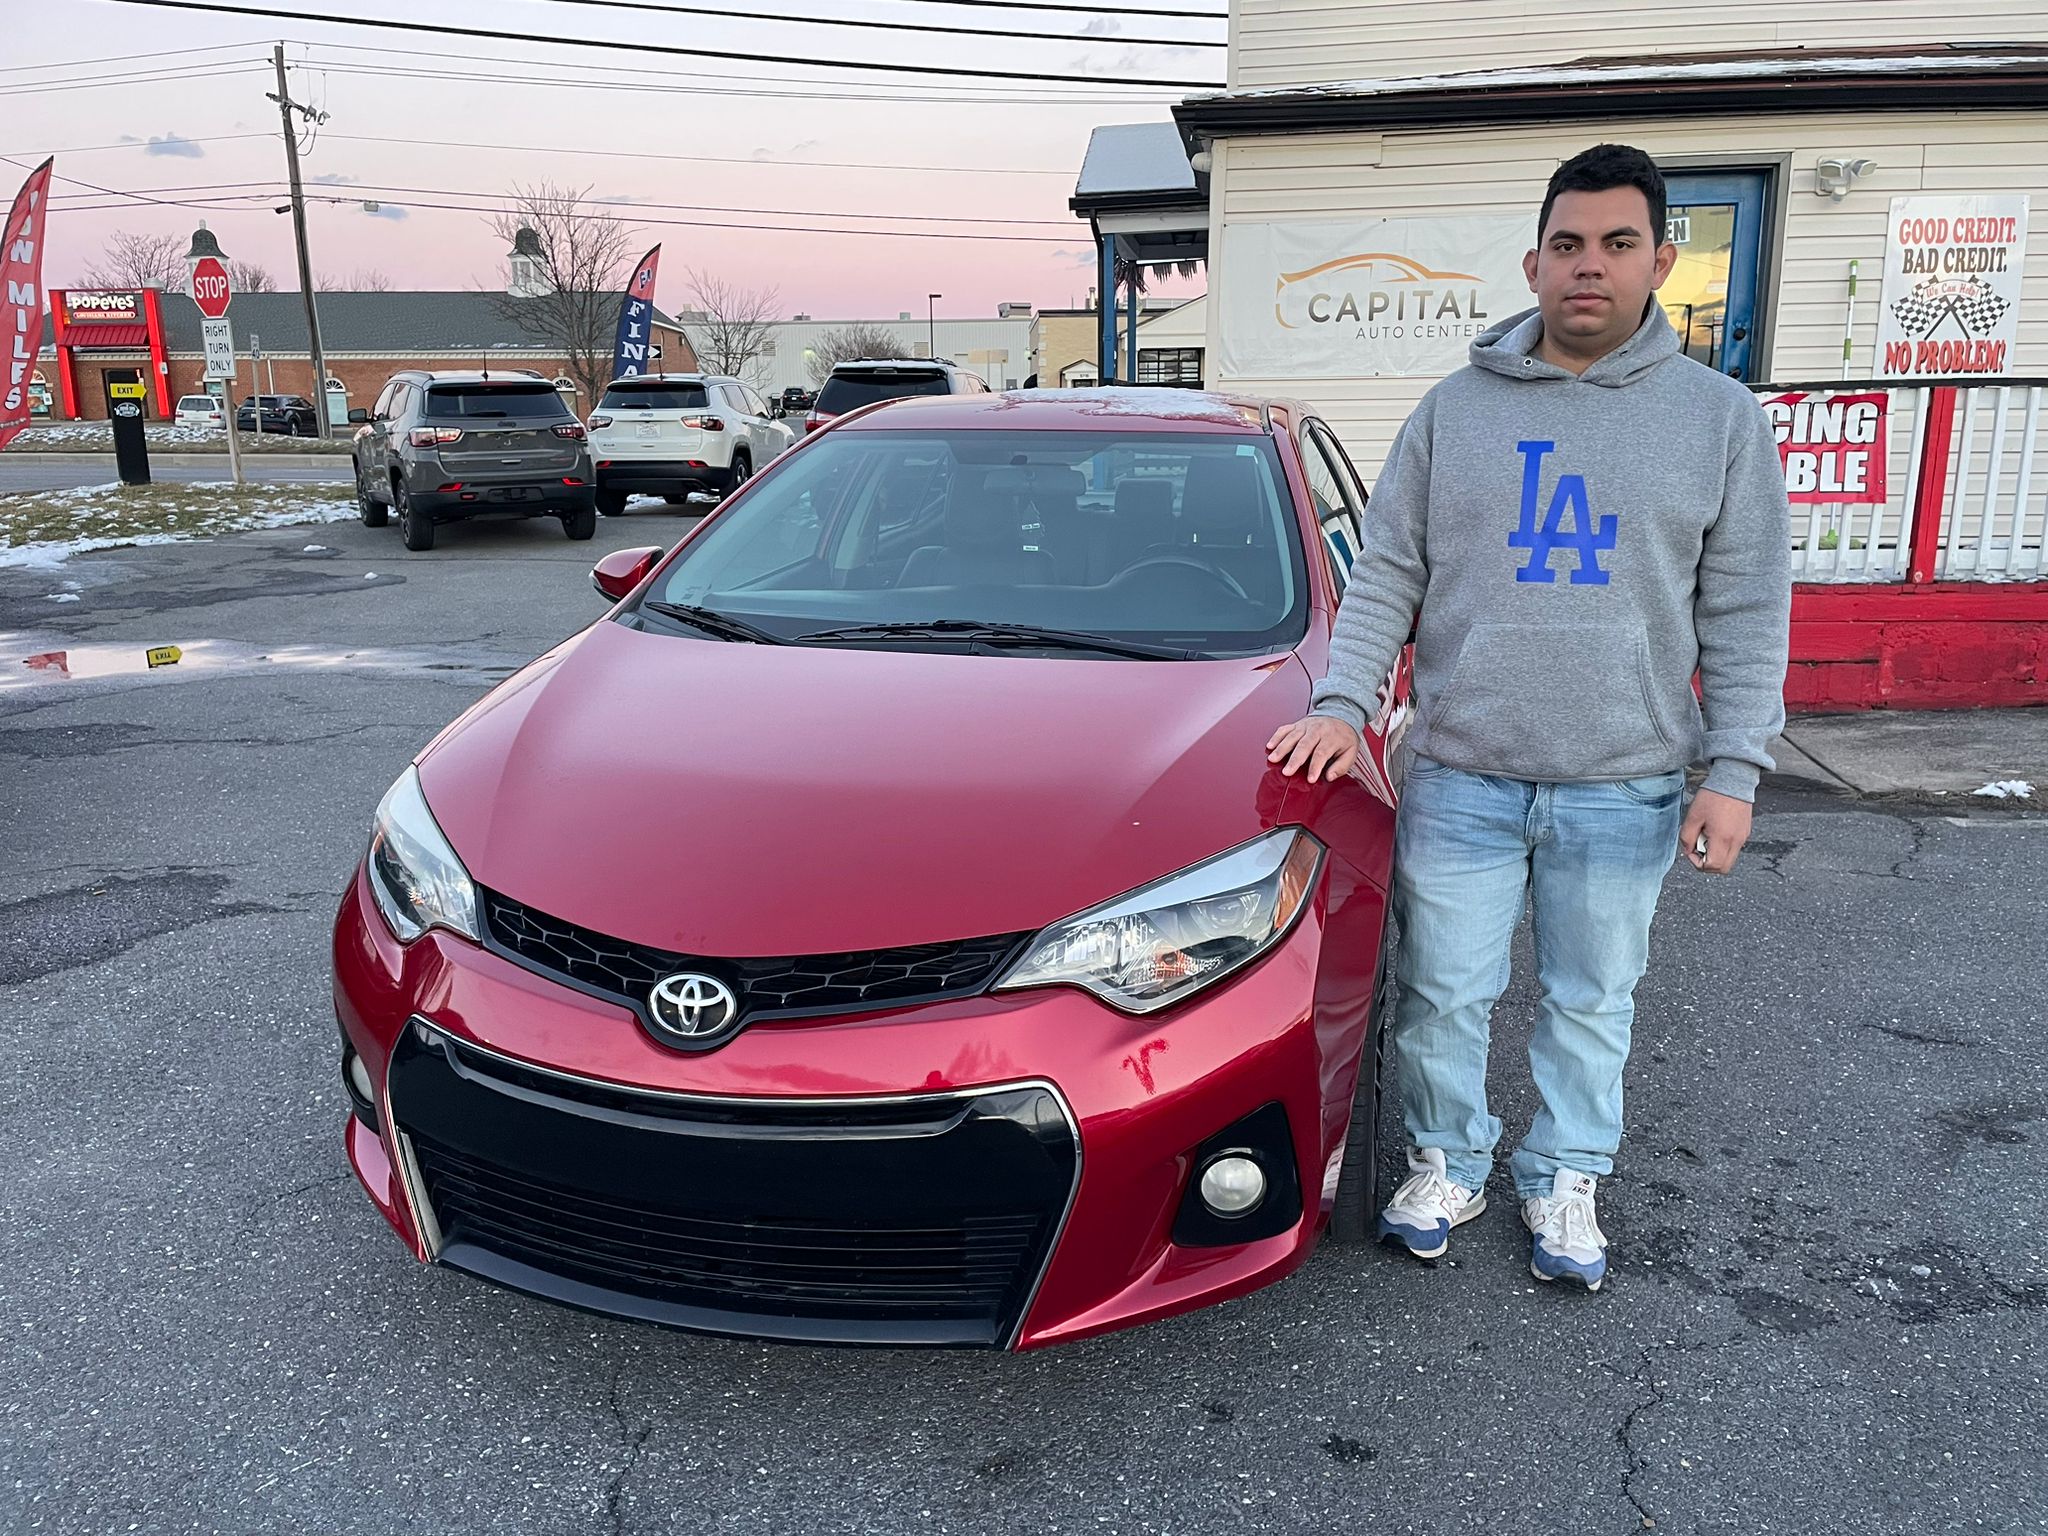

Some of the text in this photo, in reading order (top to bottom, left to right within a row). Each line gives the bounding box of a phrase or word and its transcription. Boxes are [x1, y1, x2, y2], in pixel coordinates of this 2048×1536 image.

[1898, 217, 2017, 245] GOOD CREDIT.
[1902, 247, 2007, 274] BAD CREDIT.
[195, 276, 227, 299] STOP
[1926, 287, 1939, 298] We
[1942, 283, 1956, 293] Can
[1308, 289, 1488, 323] CAPITAL
[205, 325, 228, 337] RIGHT
[1355, 326, 1404, 339] AUTO
[4, 280, 35, 410] MILES
[208, 343, 230, 354] TURN
[1883, 340, 2007, 375] NO PROBLEM!
[210, 360, 231, 371] ONLY
[1508, 441, 1618, 585] LA
